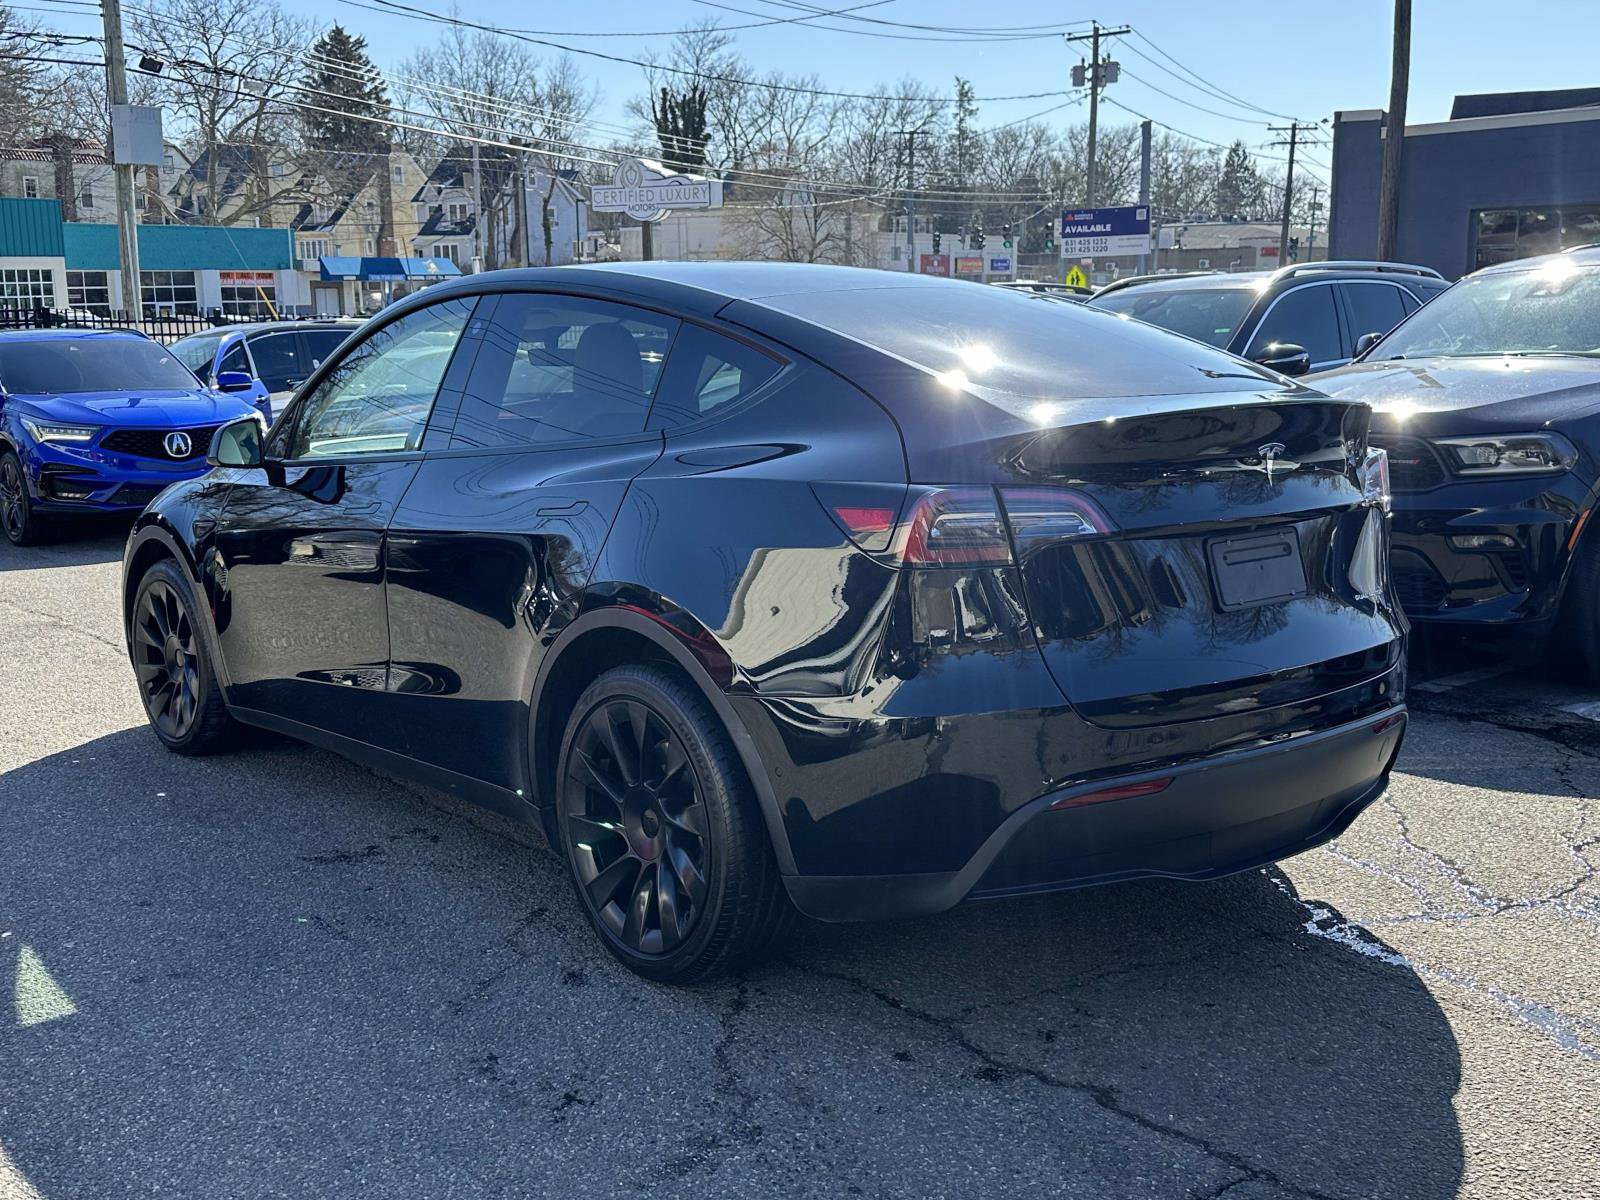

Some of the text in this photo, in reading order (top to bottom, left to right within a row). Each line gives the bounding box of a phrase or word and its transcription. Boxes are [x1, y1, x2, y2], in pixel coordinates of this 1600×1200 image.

[593, 187, 708, 203] CERTIFIED LUXURY
[628, 203, 656, 212] MOTORS
[1064, 224, 1112, 234] AVAILABLE
